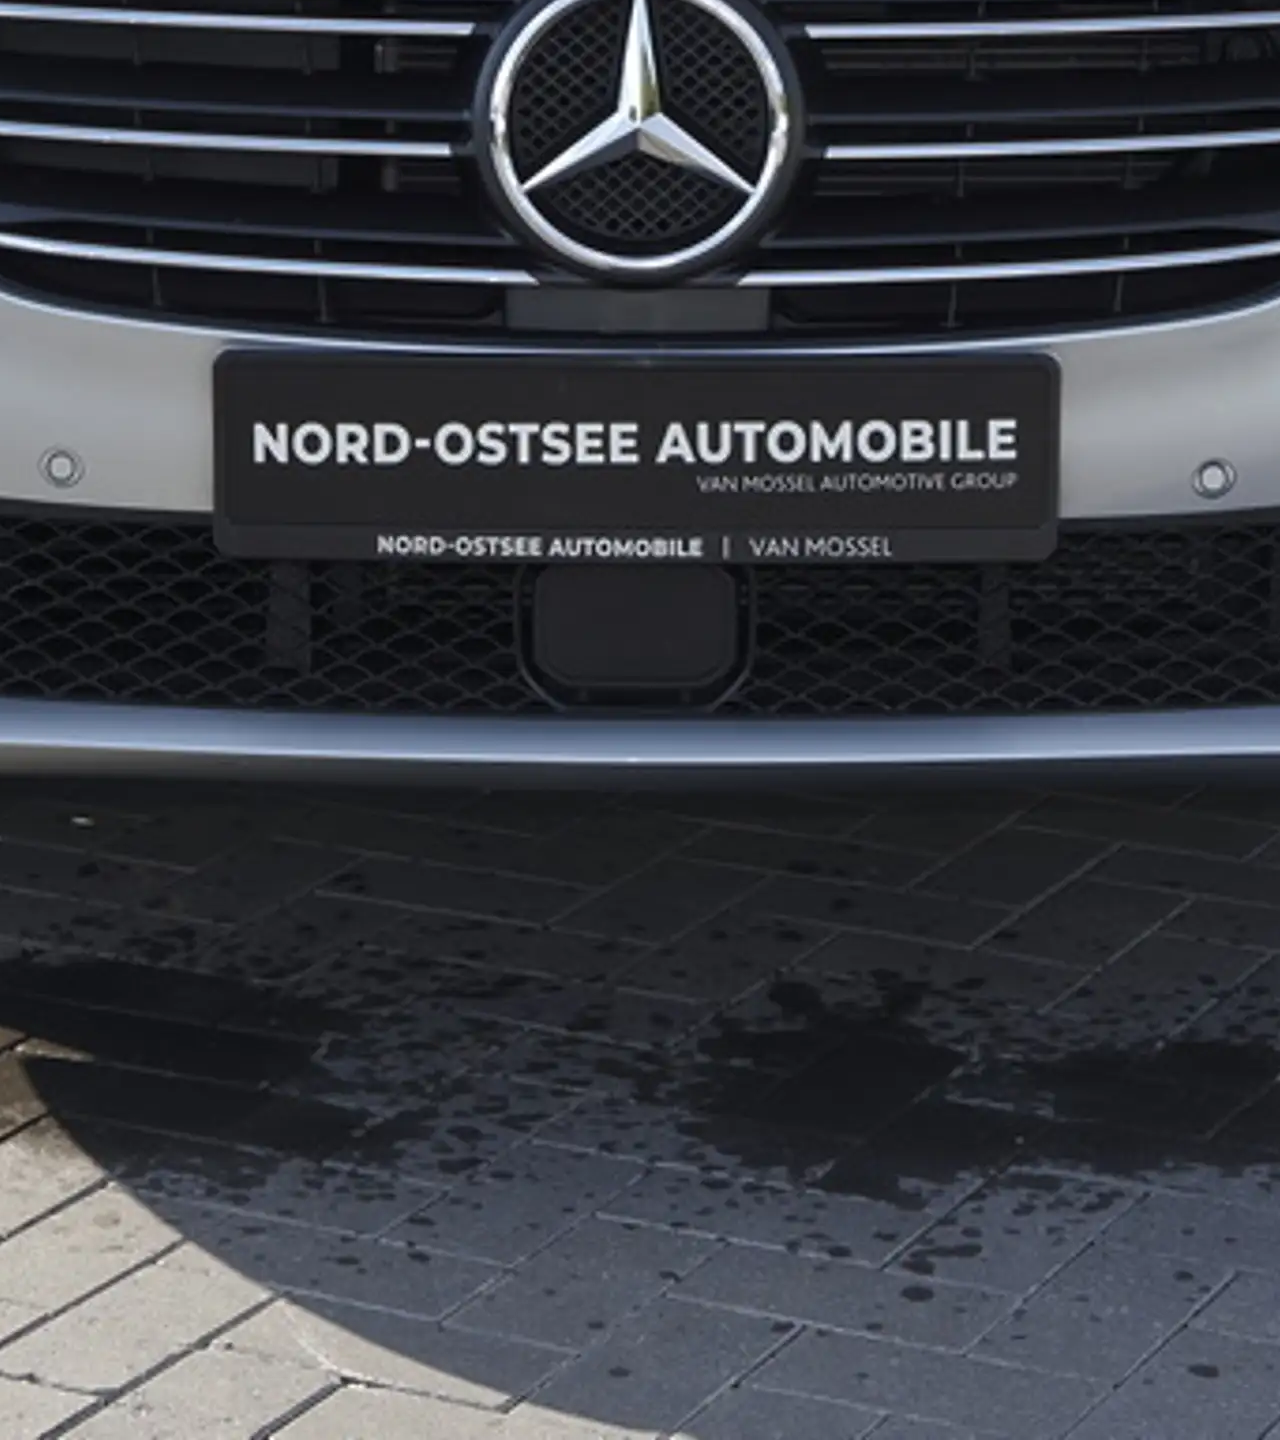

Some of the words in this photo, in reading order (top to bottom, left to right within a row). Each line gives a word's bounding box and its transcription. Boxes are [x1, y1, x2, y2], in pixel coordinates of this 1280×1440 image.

[252, 421, 640, 465] NORD-OSTSEE
[655, 418, 1019, 463] AUTOMOBILE
[696, 474, 740, 493] VAN
[742, 474, 816, 493] MOSSEL
[821, 472, 944, 493] AUTOMOTIVE
[950, 471, 1018, 490] GROUP
[376, 535, 542, 557] NORD-OSTSEE
[547, 537, 704, 558] AUTOMOBILE
[748, 536, 799, 557] VAN
[804, 536, 893, 558] MOSSEL
